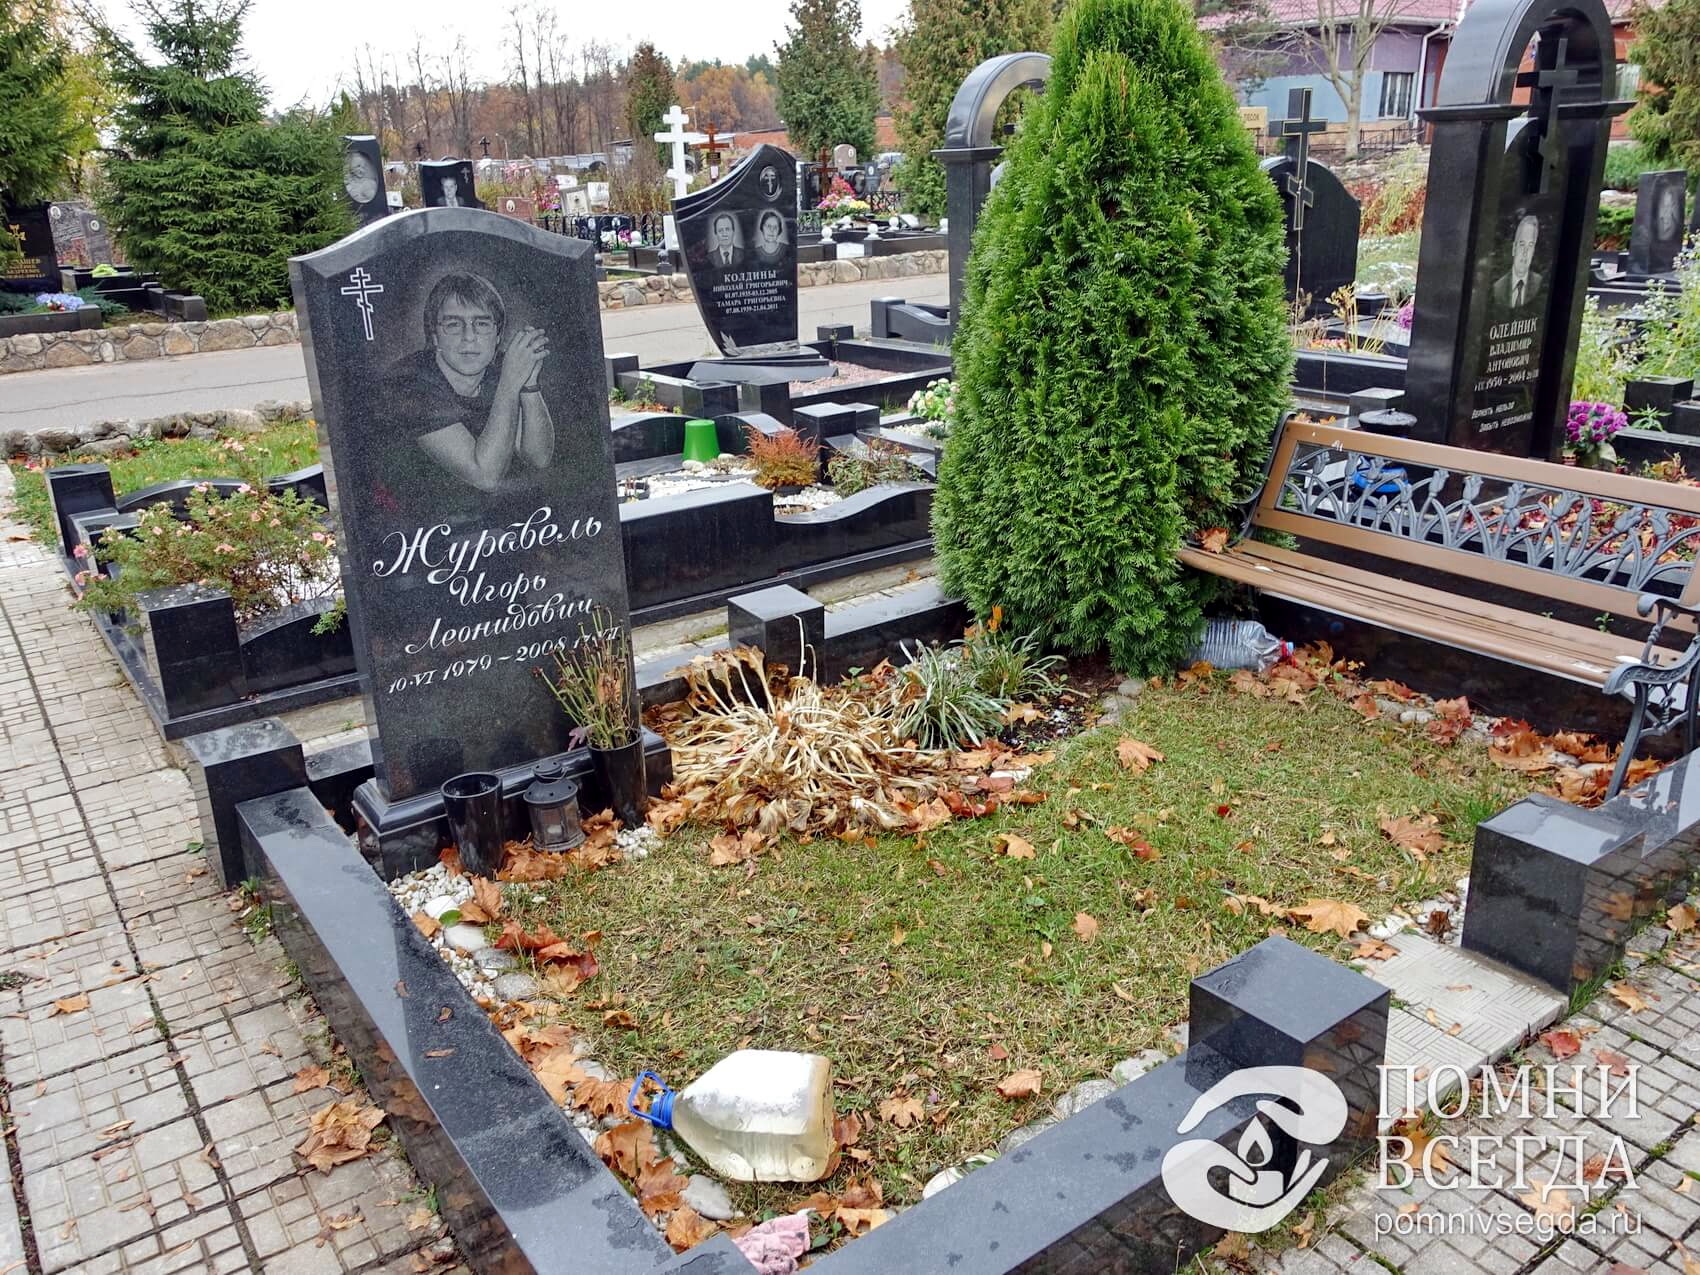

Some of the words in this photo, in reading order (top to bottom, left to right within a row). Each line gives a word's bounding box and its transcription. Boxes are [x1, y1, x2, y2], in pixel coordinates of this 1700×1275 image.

[712, 282, 744, 293] НИКОЛАЙ
[745, 279, 788, 290] ГРИГОРЬЕВИЧ
[724, 270, 777, 283] КОЛДИНЫ
[717, 299, 742, 308] ТАМАРА
[743, 295, 786, 306] ГРИГОРЬЕВНА
[1489, 317, 1538, 340] ОЛЕЙНИК
[1489, 337, 1532, 357] ВЛАДИМИР
[1486, 353, 1530, 374] АНТОНОВИЧ
[373, 507, 602, 585] Журавель
[449, 572, 547, 607] Игорь
[404, 592, 593, 654] Леонидович
[442, 654, 492, 681] 1979
[516, 636, 567, 662] 2008
